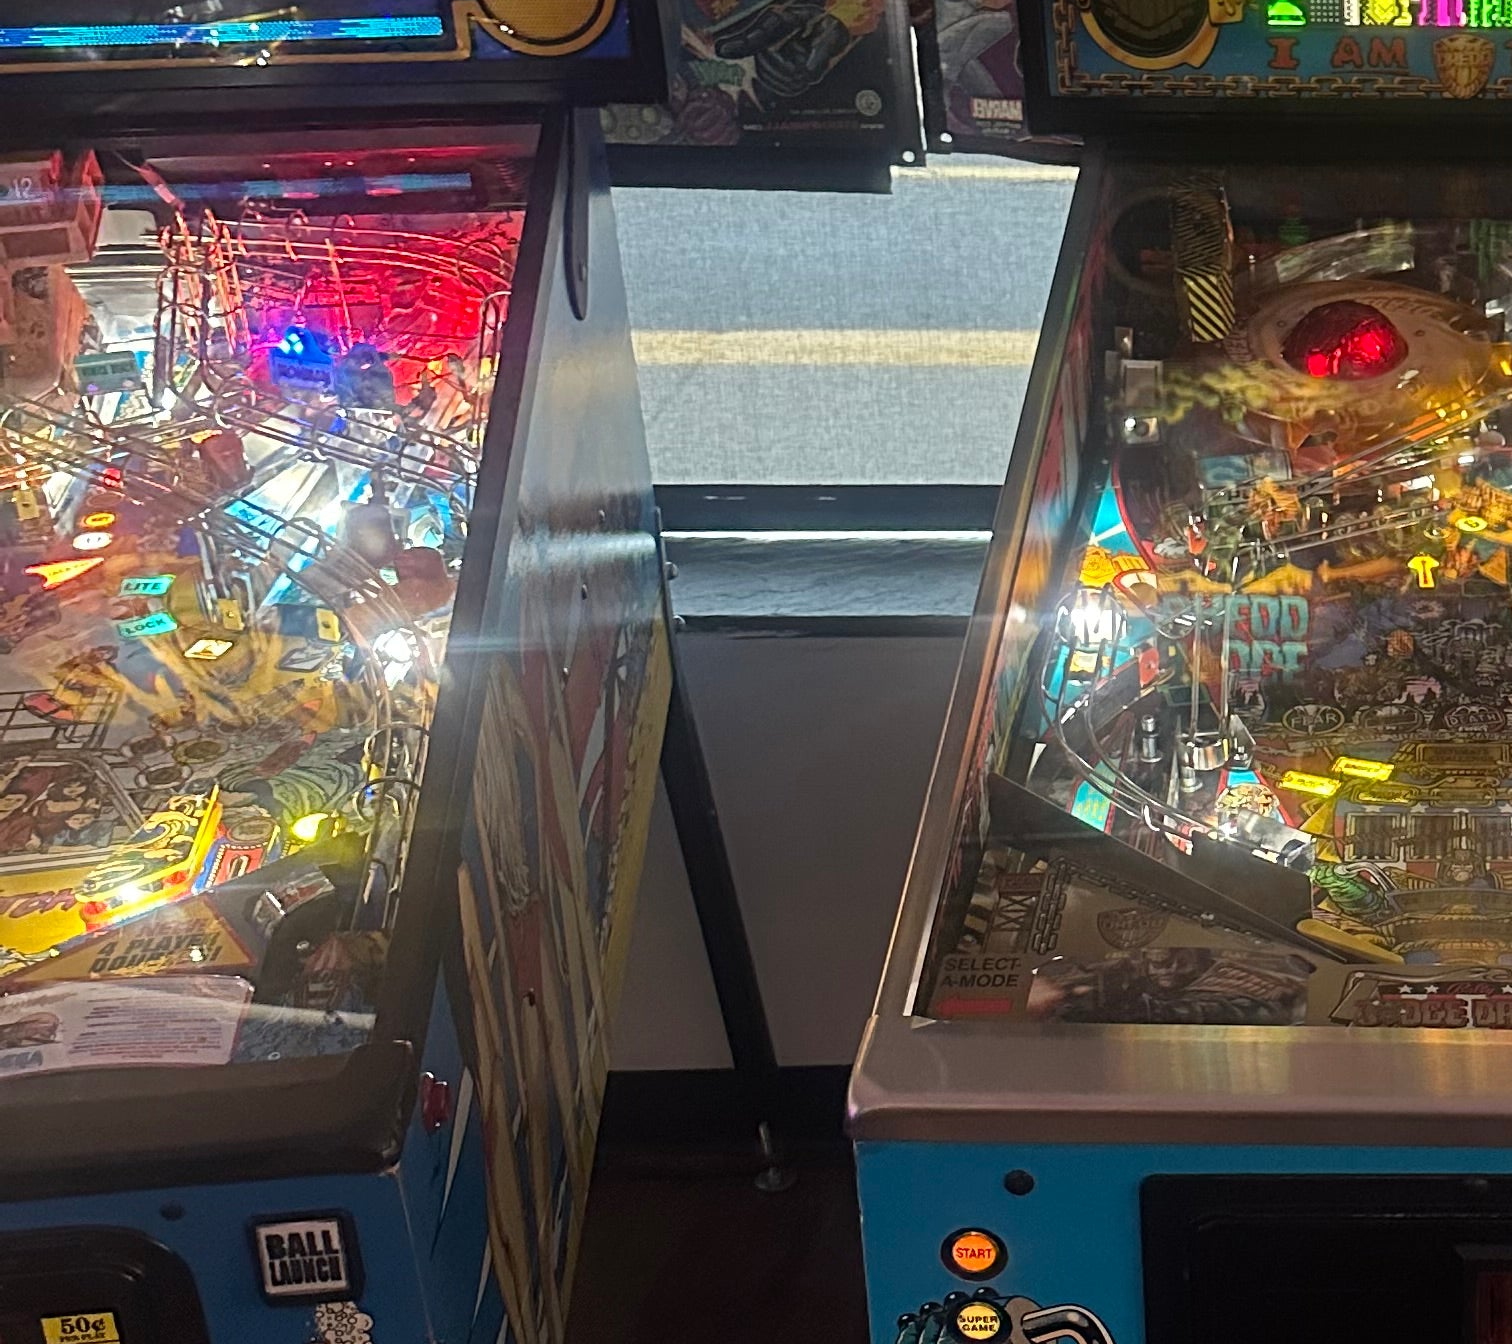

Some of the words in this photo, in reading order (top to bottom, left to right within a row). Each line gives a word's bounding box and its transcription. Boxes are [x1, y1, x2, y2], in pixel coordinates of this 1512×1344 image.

[1266, 36, 1299, 70] I
[1331, 34, 1409, 71] AM
[123, 581, 163, 592] LITE
[124, 617, 168, 636] LOCK
[940, 973, 1020, 989] A-MODE
[263, 1229, 339, 1261] BALL
[956, 1247, 992, 1260] START
[267, 1254, 343, 1287] LAUNCH
[60, 1316, 107, 1335] 50¢
[959, 1314, 998, 1324] SUPER
[961, 1323, 996, 1333] GAME
